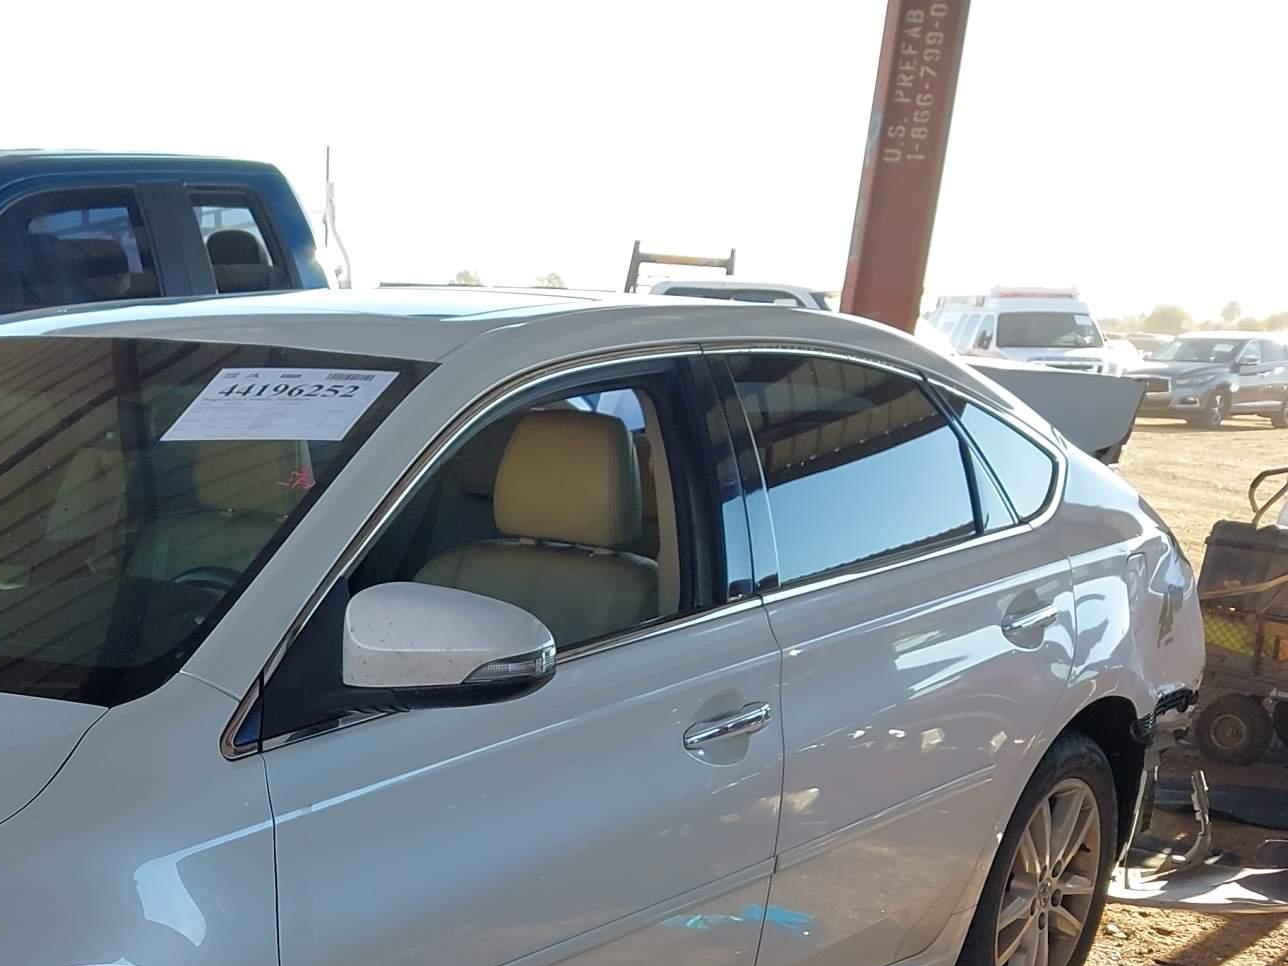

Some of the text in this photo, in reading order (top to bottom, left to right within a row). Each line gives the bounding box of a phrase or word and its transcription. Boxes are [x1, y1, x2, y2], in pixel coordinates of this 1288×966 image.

[883, 9, 925, 162] U.S. PREFAB
[219, 382, 360, 398] 44196252
